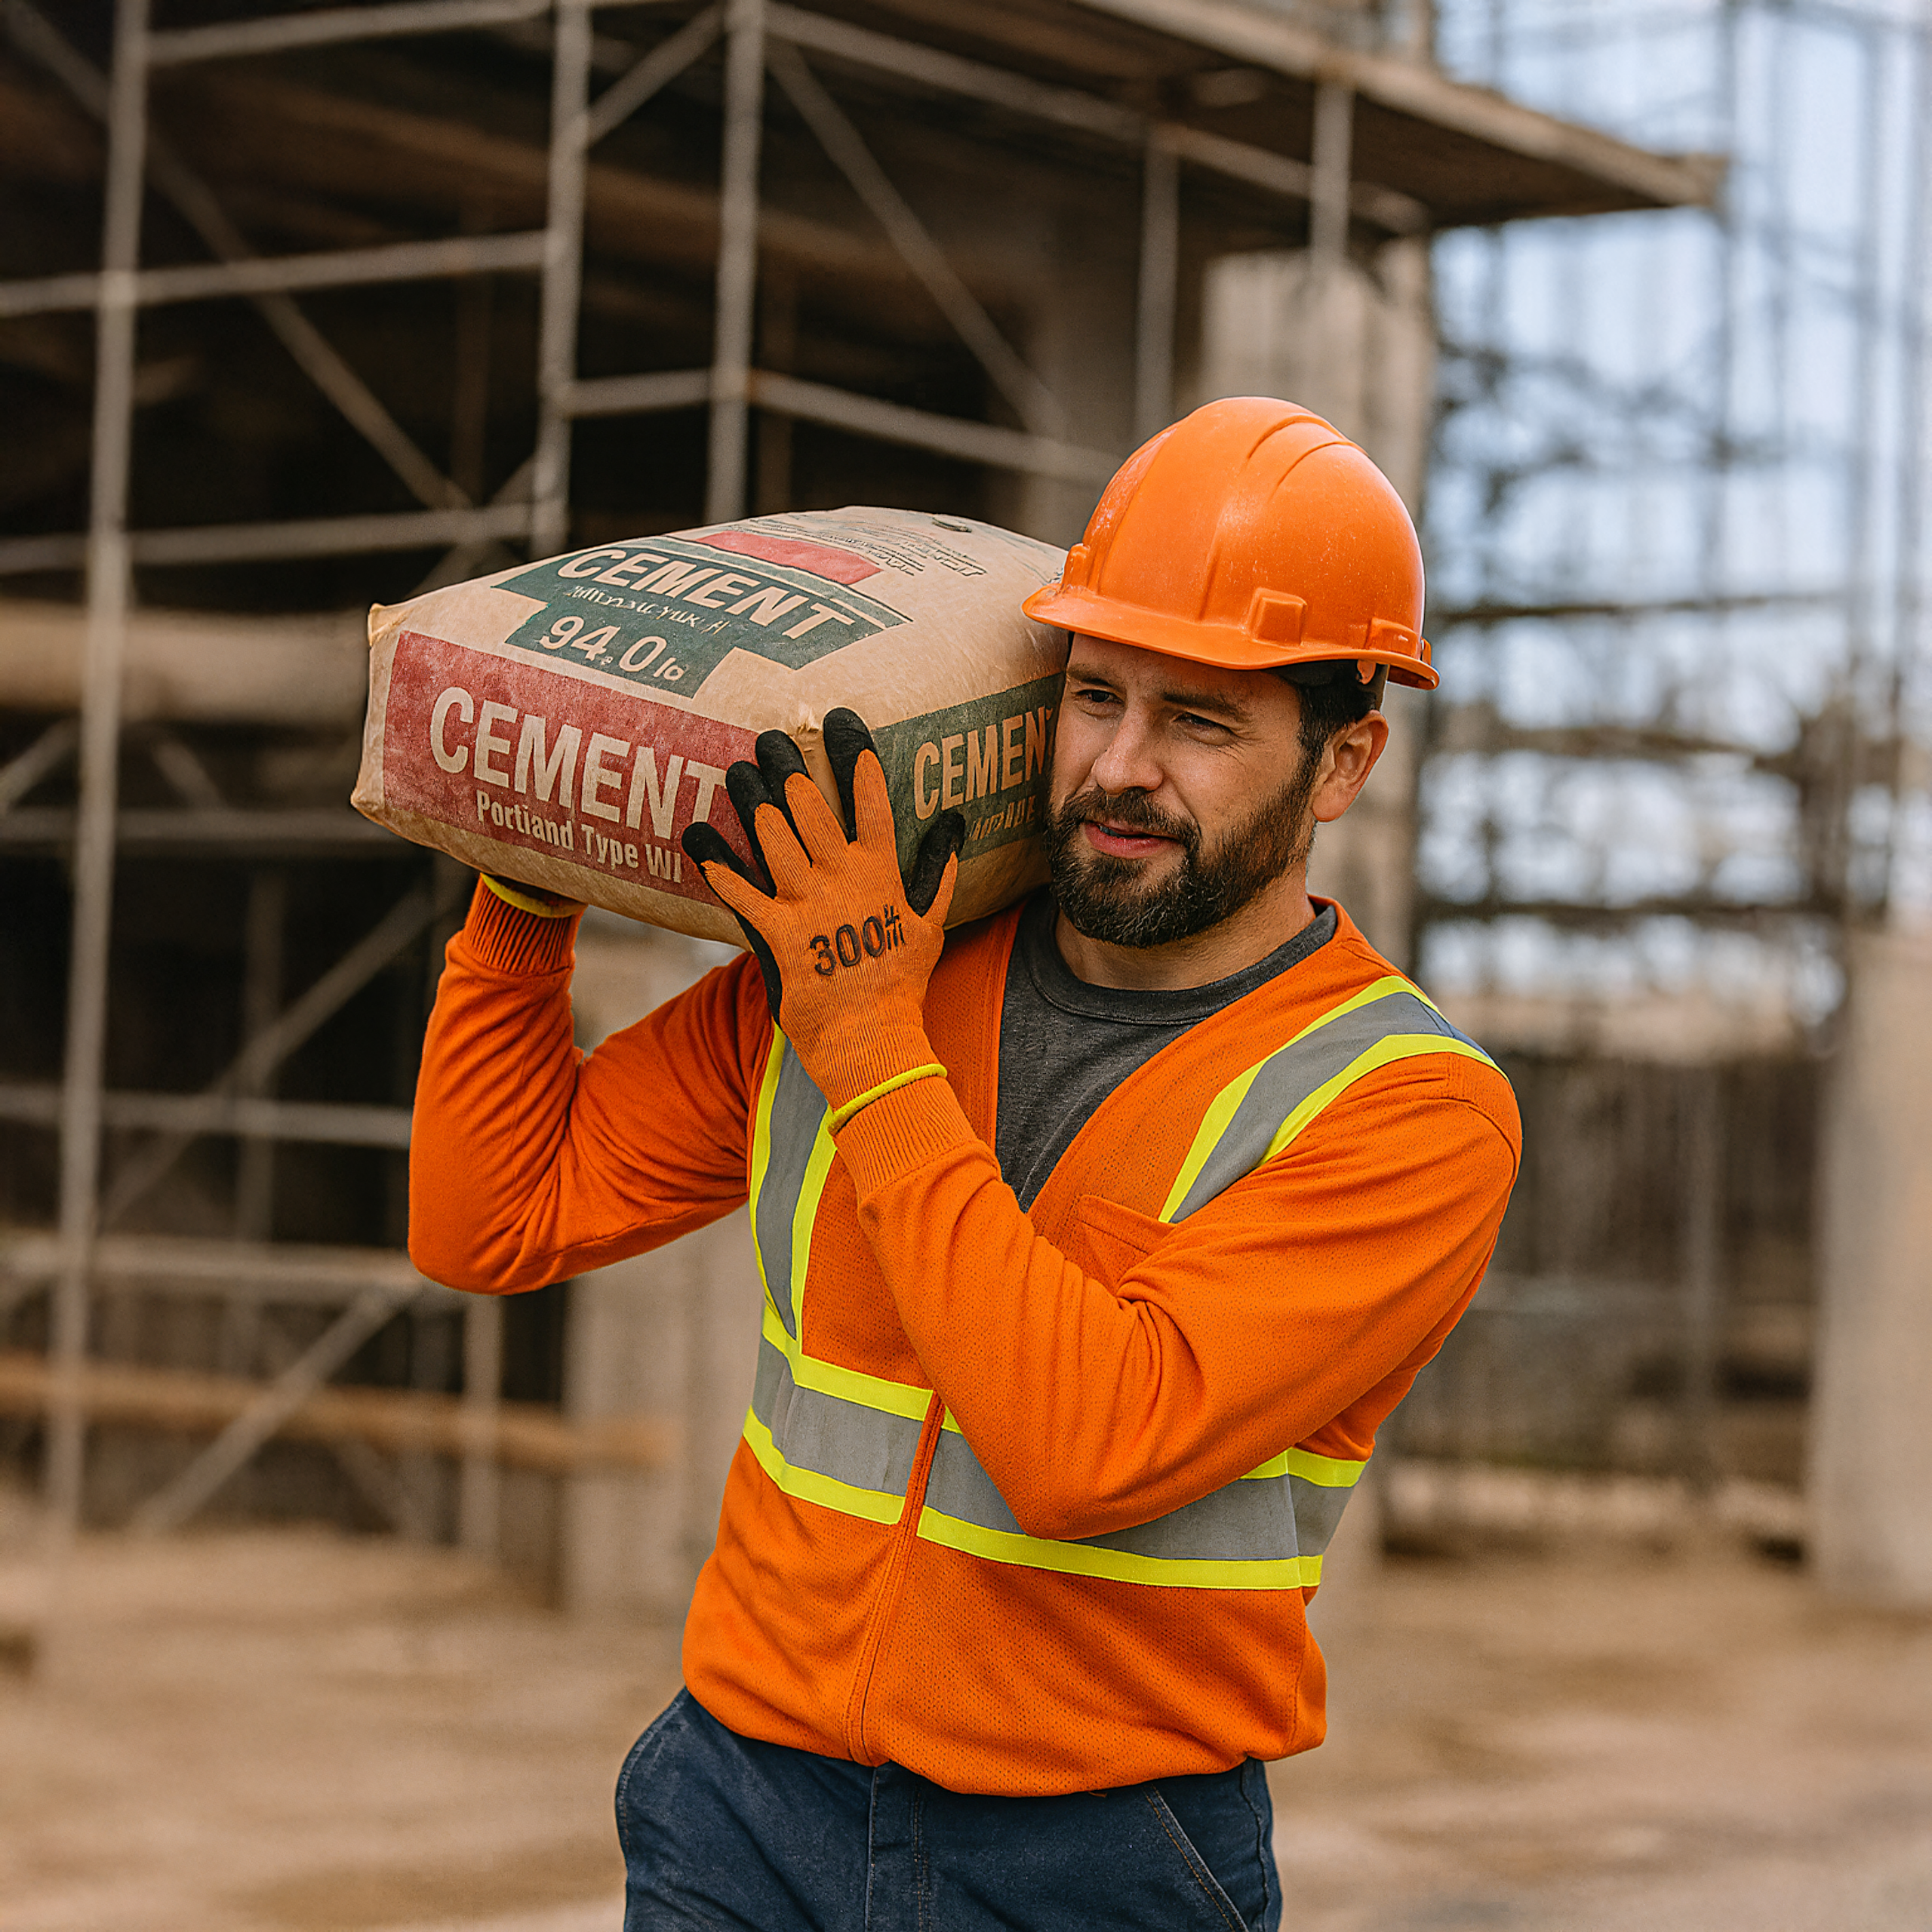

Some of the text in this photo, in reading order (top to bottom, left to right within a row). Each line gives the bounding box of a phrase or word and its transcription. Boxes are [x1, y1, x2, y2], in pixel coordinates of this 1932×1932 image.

[557, 549, 856, 640] CEMENT
[429, 686, 727, 840] CEMENT
[580, 823, 639, 870] Type
